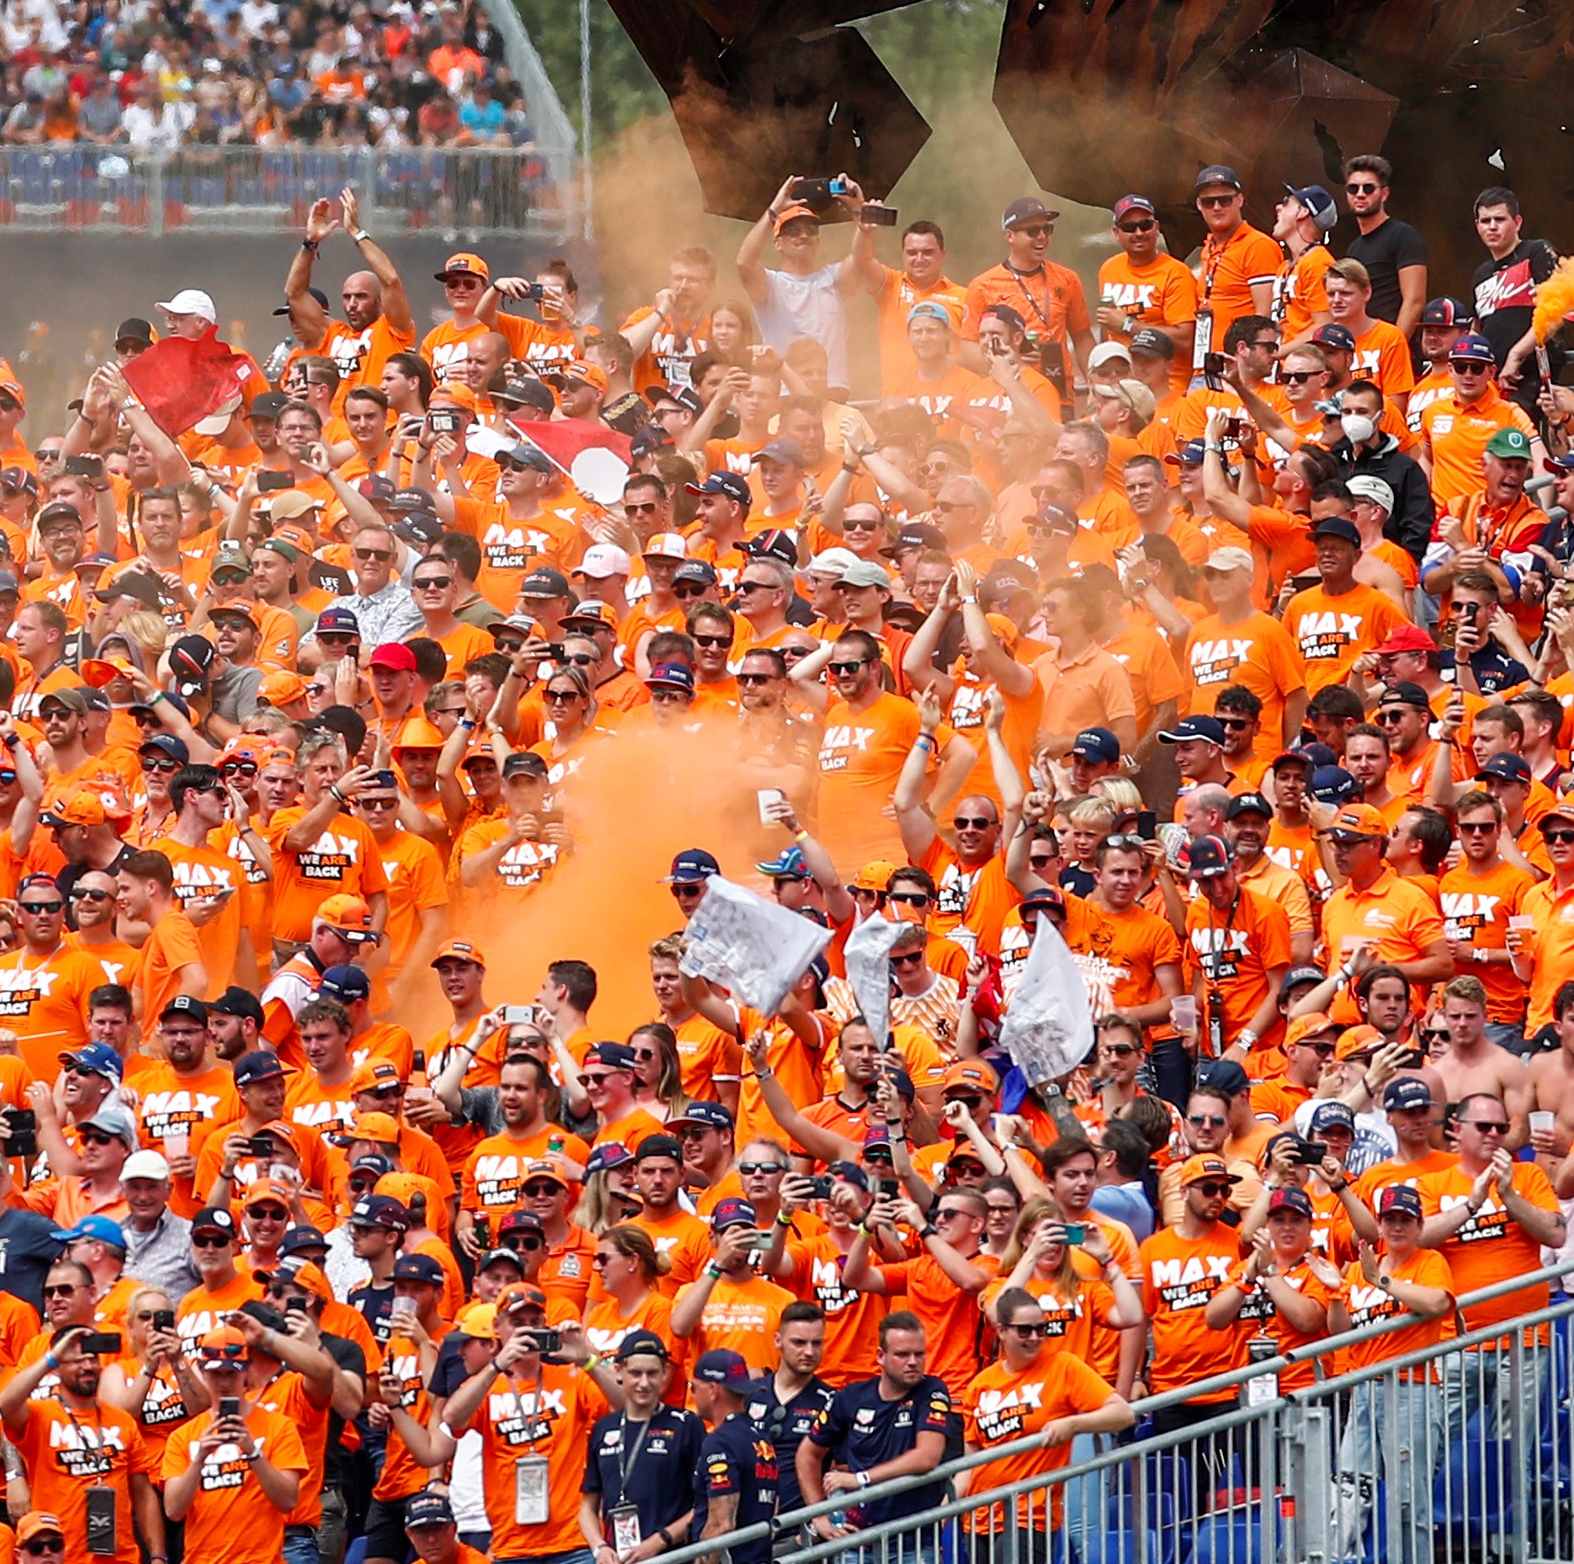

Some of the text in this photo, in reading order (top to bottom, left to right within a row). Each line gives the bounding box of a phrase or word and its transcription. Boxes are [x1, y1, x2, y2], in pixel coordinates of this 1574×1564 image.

[1102, 282, 1156, 308] MAX
[527, 343, 575, 361] MAX
[483, 523, 551, 552] MAX
[488, 546, 531, 556] WE ARE
[492, 556, 523, 567] BACK
[1299, 612, 1363, 640] MAX
[1319, 634, 1344, 645] ARE
[1192, 639, 1253, 662] MAX
[1305, 645, 1336, 657] BACK
[1194, 664, 1212, 675] WE
[1197, 670, 1229, 683] BACK
[824, 726, 875, 750] MAX
[298, 854, 347, 865] WE ARE
[173, 863, 231, 885] MAX
[306, 866, 340, 878] BACK
[177, 886, 195, 897] WE
[1440, 893, 1502, 921] MAX
[1458, 916, 1480, 926] ARE
[13, 990, 37, 1001] ARE
[143, 1091, 221, 1117] MAX
[147, 1112, 199, 1127] WE ARE
[152, 1125, 188, 1136] BACK
[479, 1182, 497, 1193] WE
[484, 1191, 517, 1203] BACK
[1479, 1212, 1508, 1225] ARE
[1461, 1226, 1503, 1240] BACK
[1152, 1256, 1233, 1287] MAX
[817, 1287, 840, 1298] WE
[1163, 1280, 1214, 1298] WE ARE
[1173, 1294, 1207, 1308] BACK
[979, 1382, 1044, 1412] MAX
[145, 1406, 185, 1423] BACK
[978, 1405, 1026, 1427] WE ARE
[987, 1419, 1020, 1438] BACK
[204, 1473, 242, 1488] BACK
